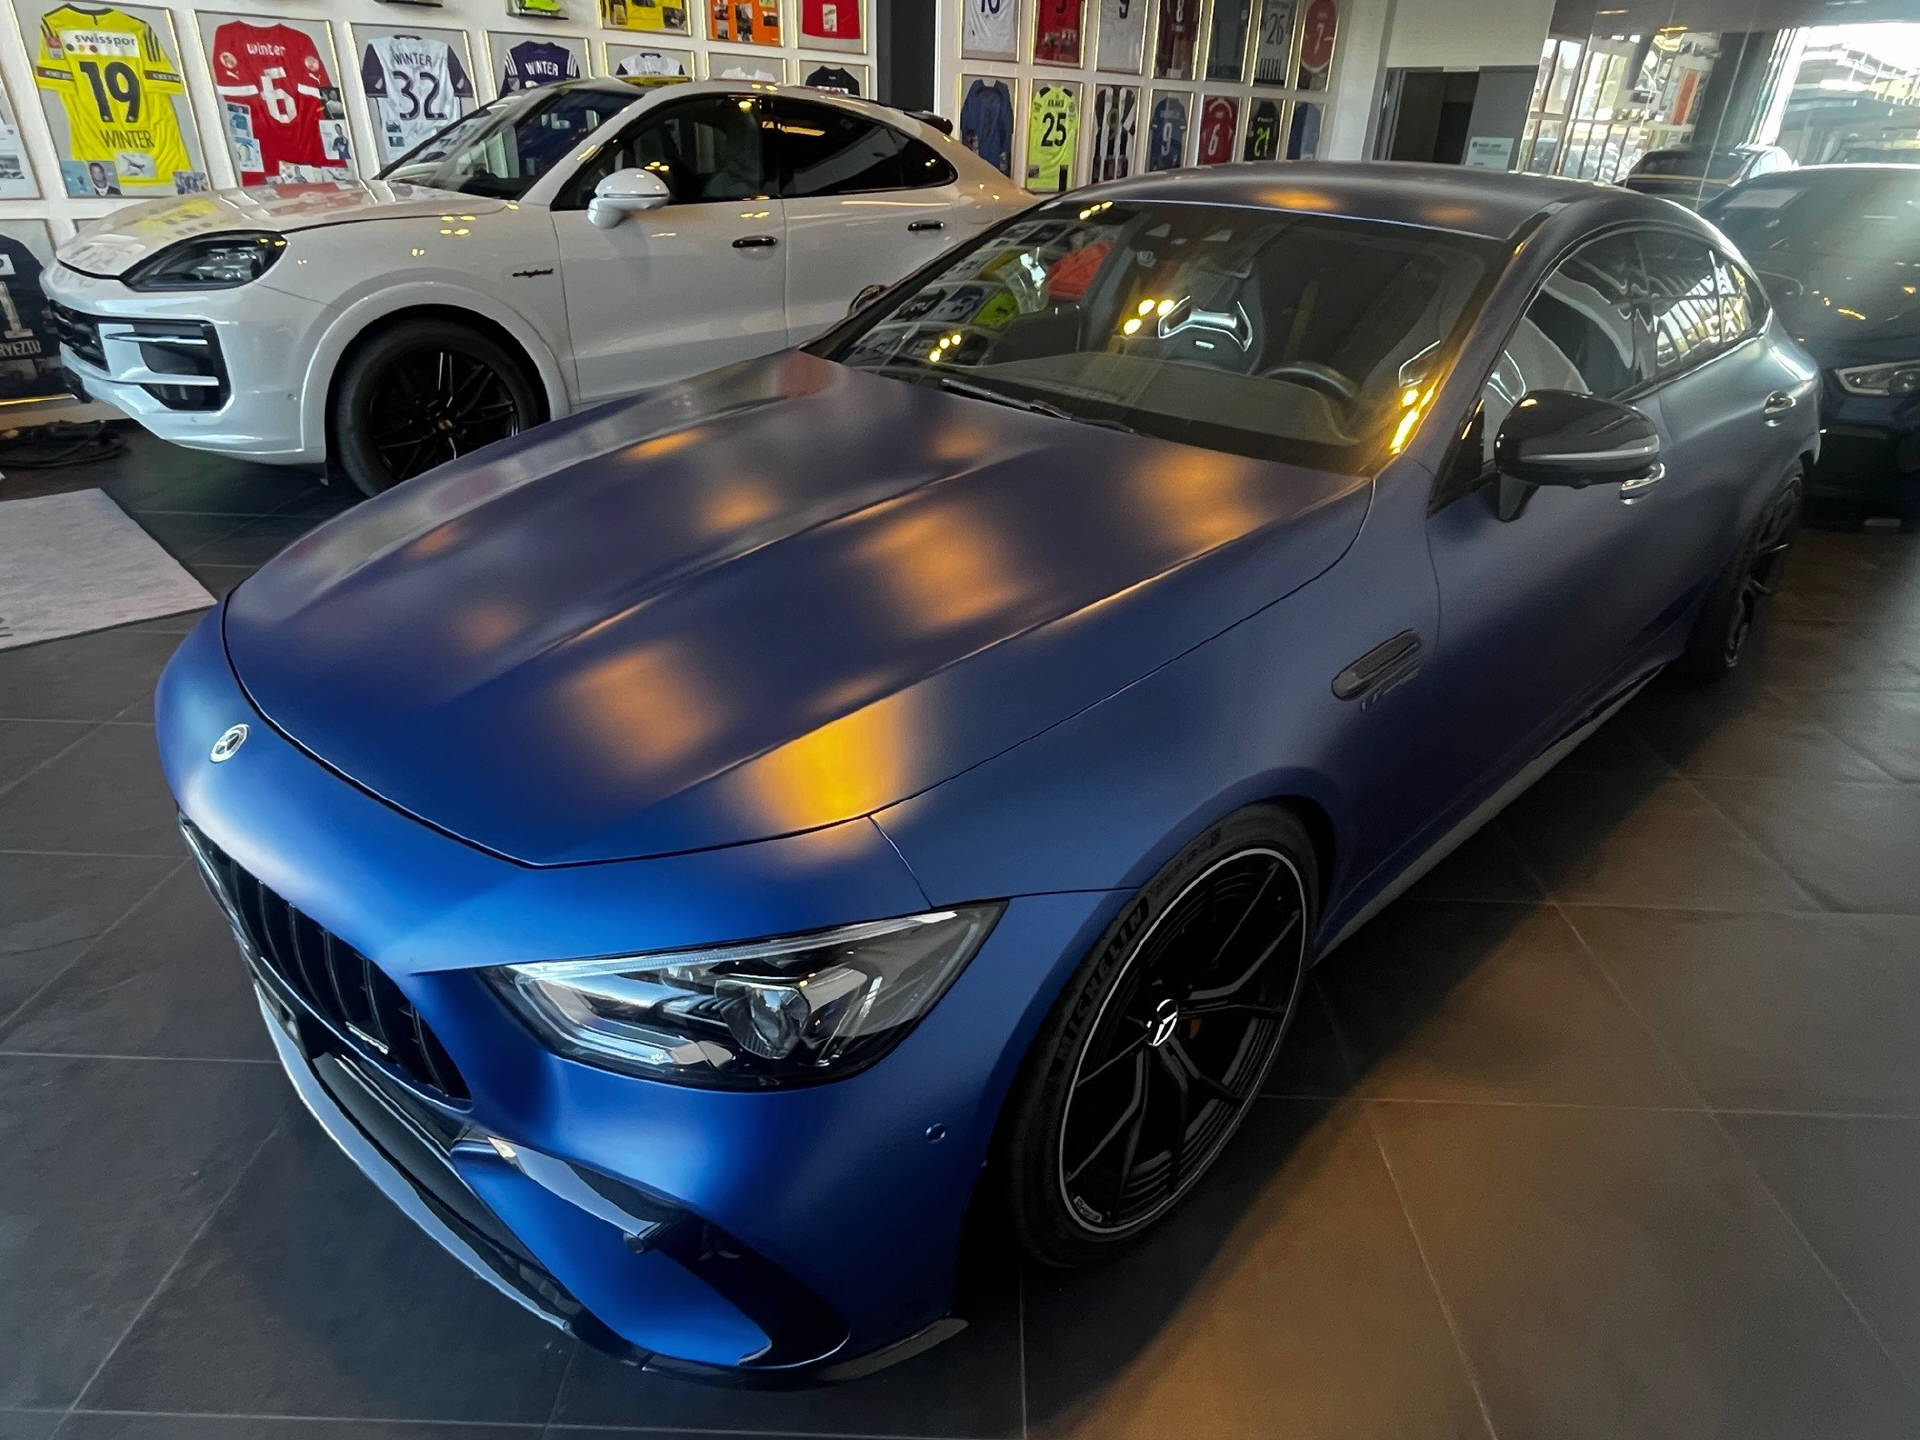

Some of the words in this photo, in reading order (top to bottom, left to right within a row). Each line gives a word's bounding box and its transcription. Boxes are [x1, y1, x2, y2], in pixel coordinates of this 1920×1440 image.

[74, 33, 136, 47] swisspor
[246, 42, 286, 57] winter
[392, 52, 433, 66] WINTER
[525, 60, 559, 76] WINTER
[79, 61, 141, 123] 19
[260, 66, 298, 123] 6
[392, 70, 448, 120] 32
[100, 129, 155, 148] WINTER
[1041, 112, 1067, 146] 25
[1161, 122, 1172, 156] 9
[1208, 123, 1221, 156] 6
